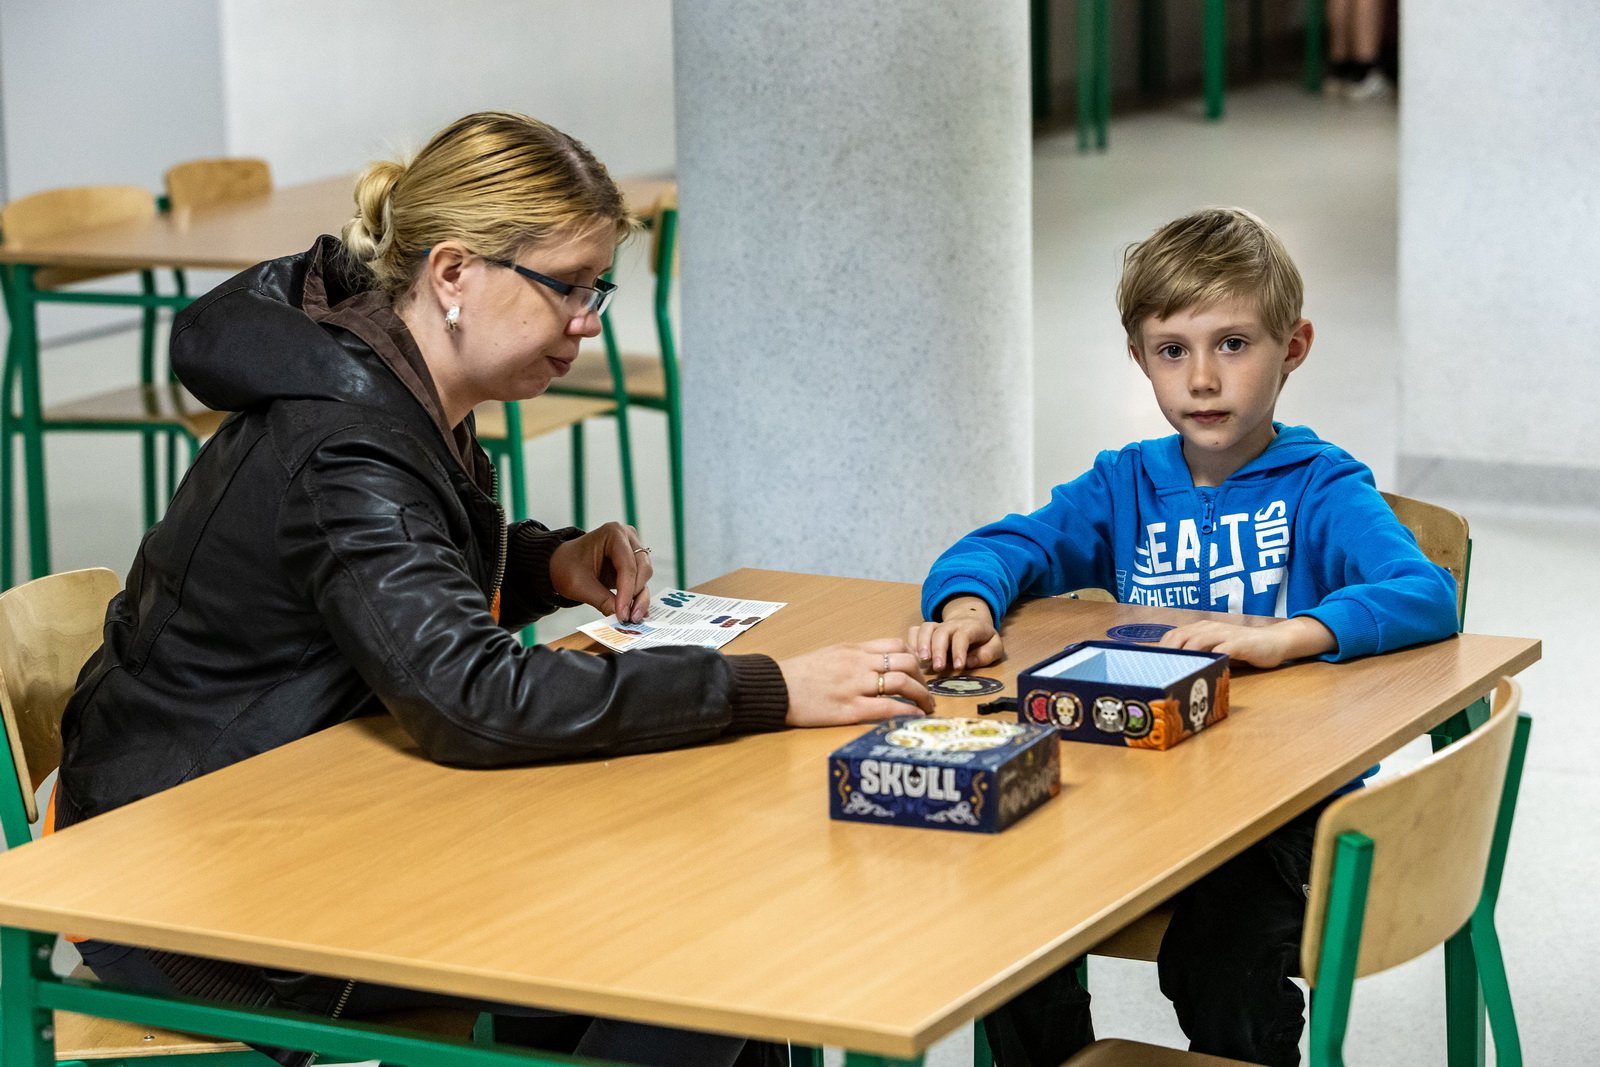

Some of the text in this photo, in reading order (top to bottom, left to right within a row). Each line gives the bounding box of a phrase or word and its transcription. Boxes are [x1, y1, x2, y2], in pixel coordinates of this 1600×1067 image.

[1254, 500, 1290, 568] SIDE
[1128, 585, 1200, 607] ATHLETIC
[860, 759, 962, 801] SKULL
